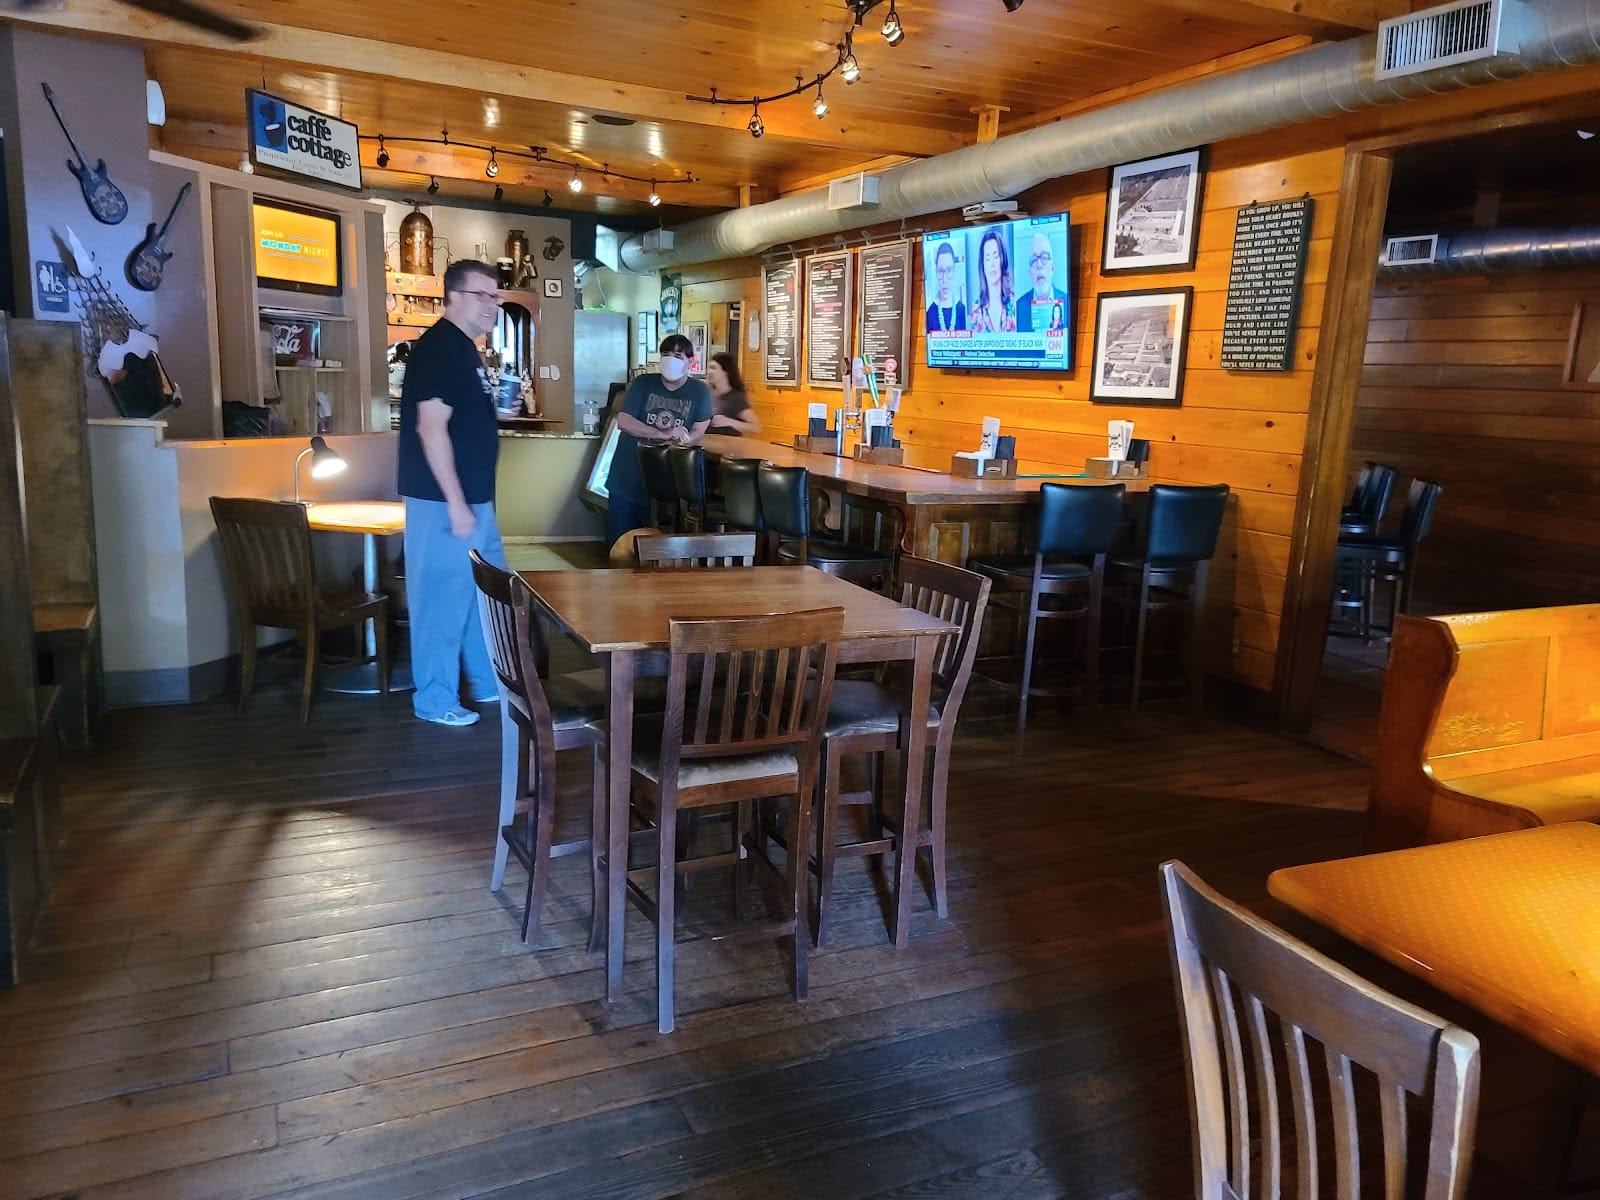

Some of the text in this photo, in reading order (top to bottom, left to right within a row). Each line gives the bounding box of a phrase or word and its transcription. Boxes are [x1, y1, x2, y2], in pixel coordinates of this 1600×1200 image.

[287, 135, 352, 169] cottage
[261, 239, 330, 258] MONDAY NIGHTS
[1048, 341, 1062, 350] CNN
